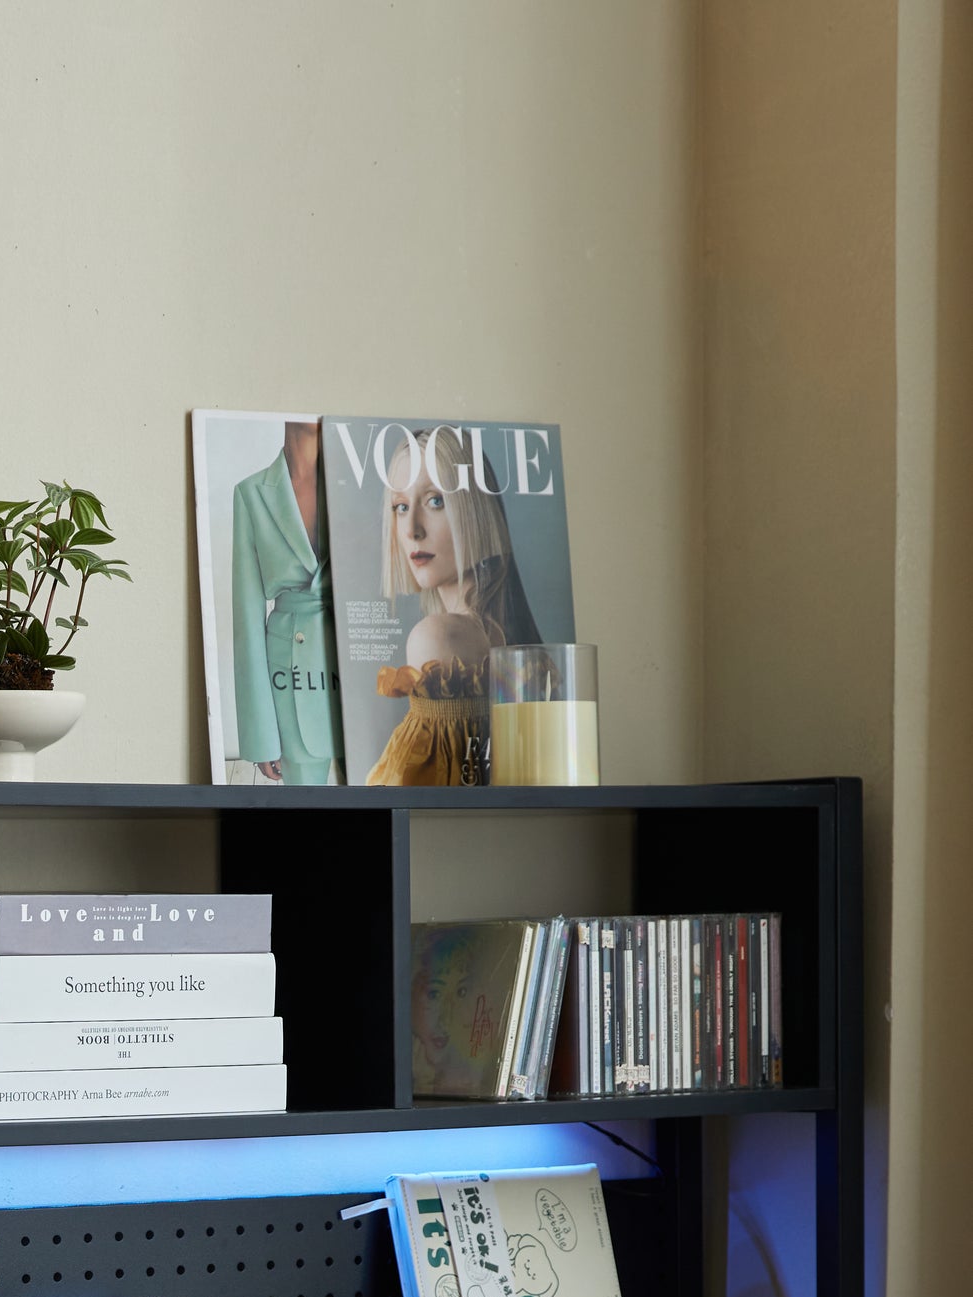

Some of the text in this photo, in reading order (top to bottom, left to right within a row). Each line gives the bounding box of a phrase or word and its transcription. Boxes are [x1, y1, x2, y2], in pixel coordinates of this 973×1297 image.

[330, 422, 554, 496] VOGUE
[20, 903, 215, 922] Love Love
[92, 923, 144, 942] and
[65, 974, 206, 998] Something you like
[77, 1033, 174, 1045] STILETTO BOOK
[82, 1089, 103, 1100] Arna
[105, 1089, 122, 1099] Bee
